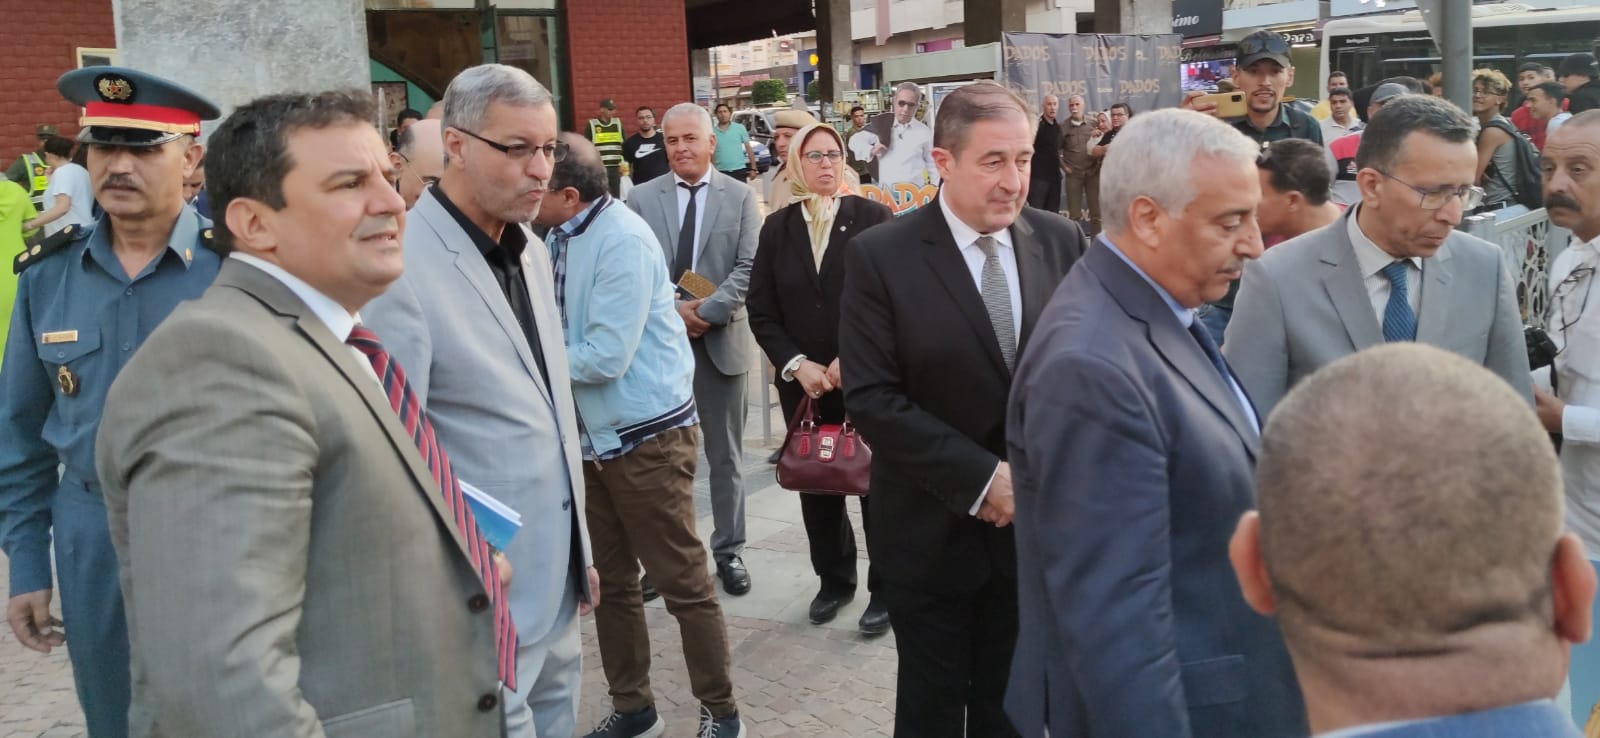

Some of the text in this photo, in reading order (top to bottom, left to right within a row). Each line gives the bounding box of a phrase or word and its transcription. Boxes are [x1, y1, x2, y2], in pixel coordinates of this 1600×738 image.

[1003, 46, 1048, 61] PADOS
[1041, 81, 1087, 96] PADOS
[1120, 79, 1160, 94] PADOS
